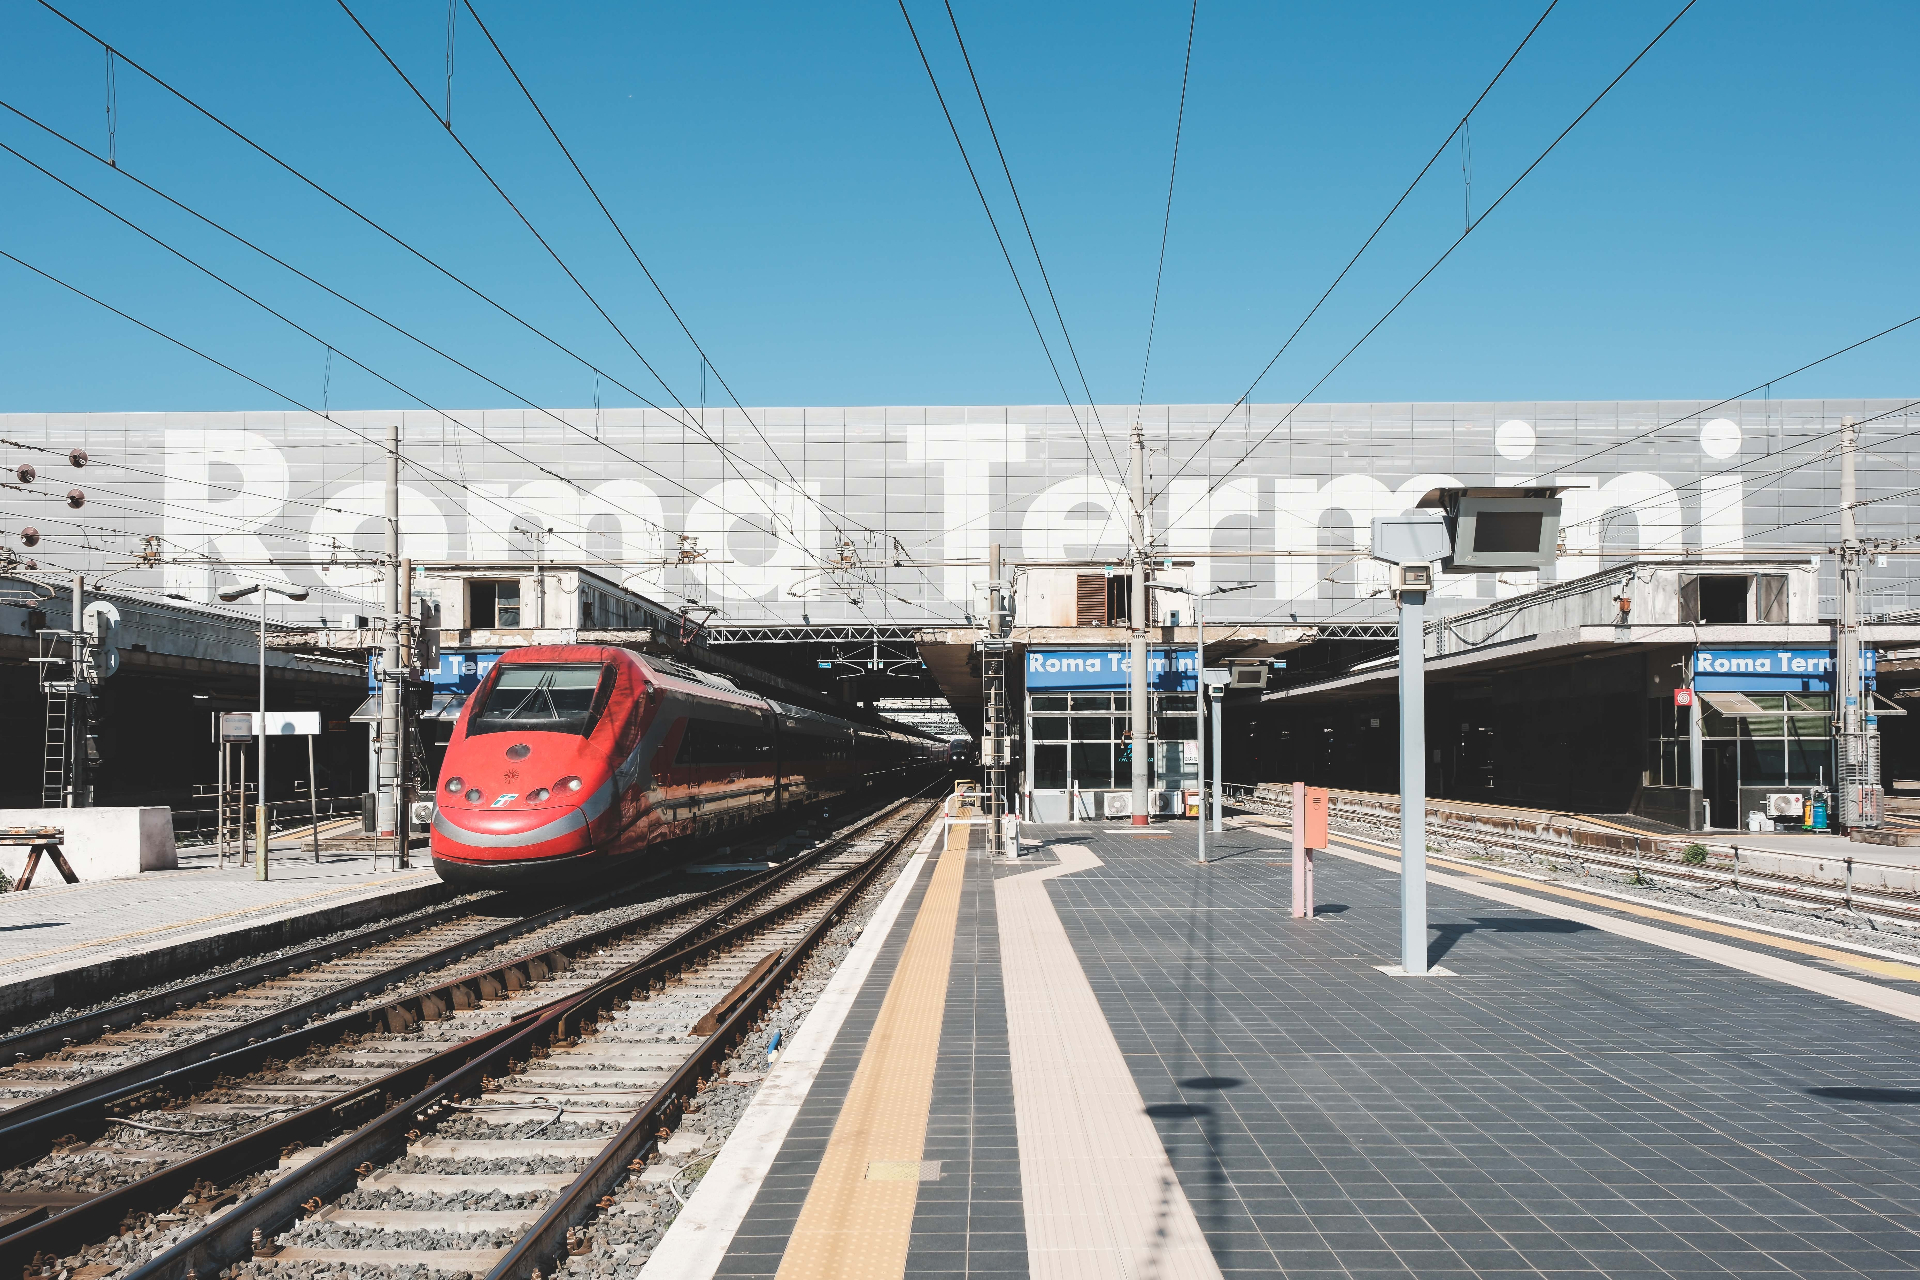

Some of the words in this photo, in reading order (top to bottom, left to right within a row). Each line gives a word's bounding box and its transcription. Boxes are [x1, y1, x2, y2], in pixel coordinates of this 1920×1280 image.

[164, 429, 821, 605] Roma
[1029, 653, 1101, 673] Roma
[1107, 653, 1199, 673] Temini
[1697, 653, 1770, 673] Roma
[1777, 652, 1873, 672] Termi
